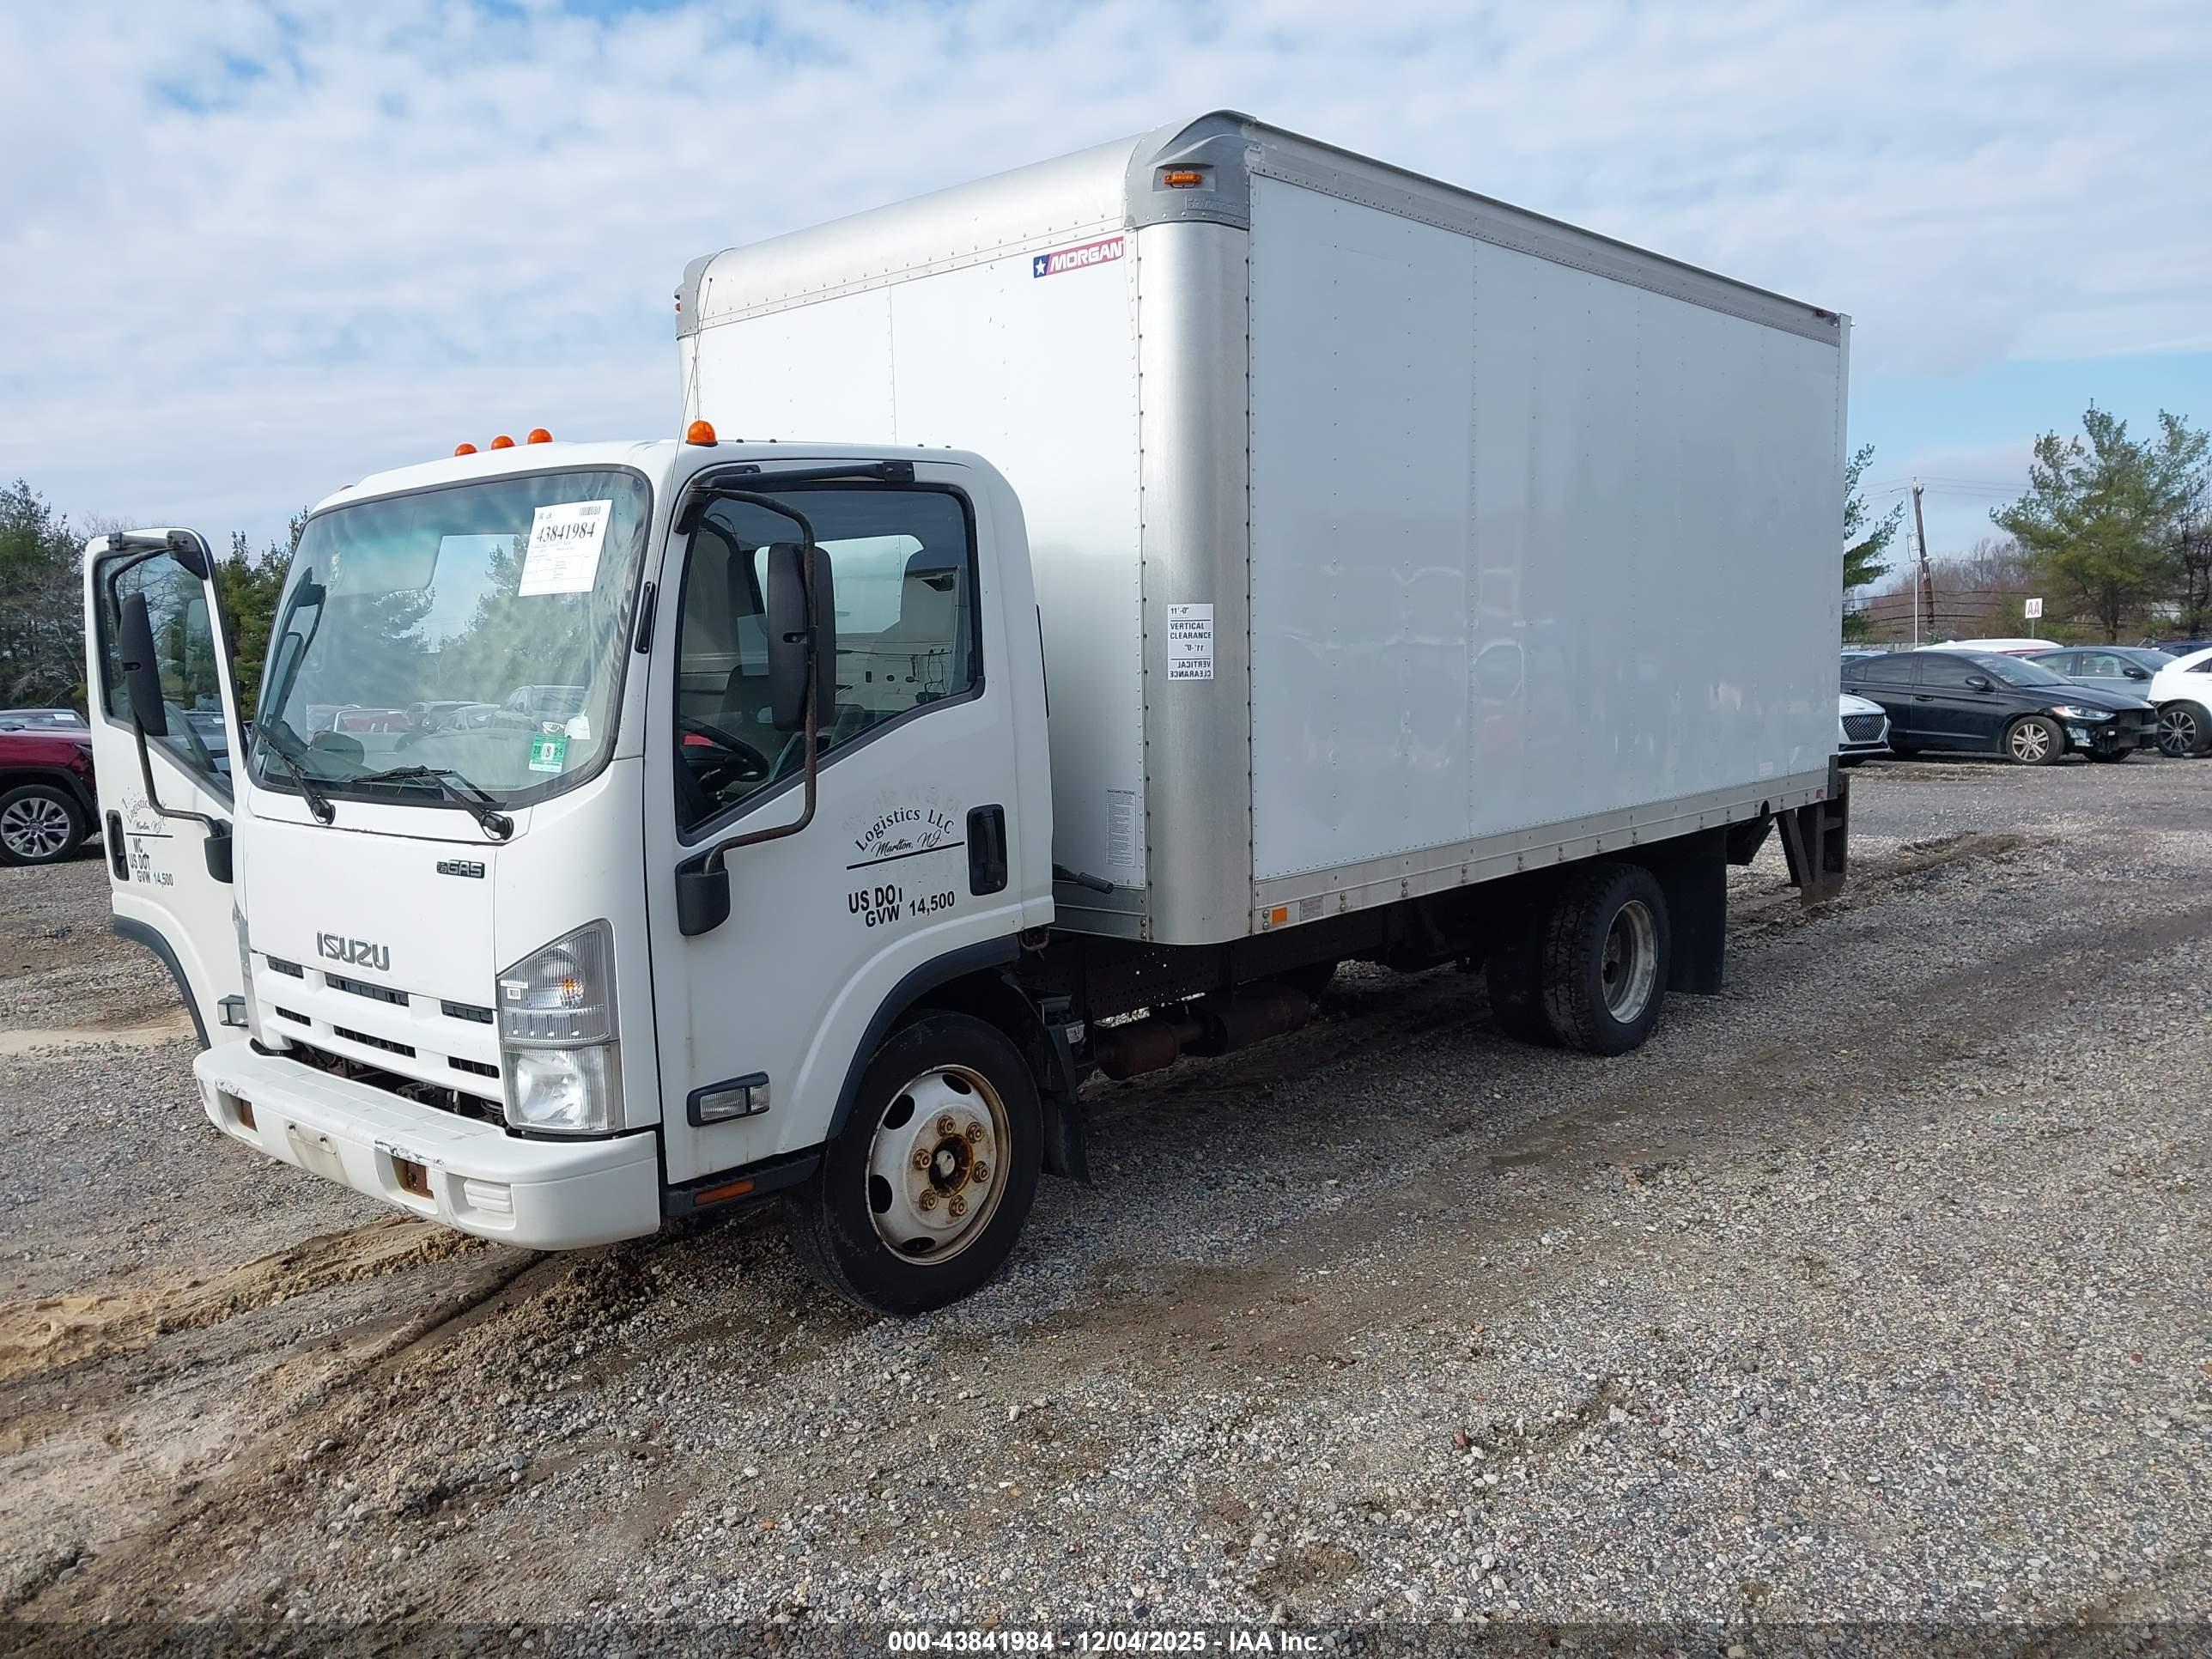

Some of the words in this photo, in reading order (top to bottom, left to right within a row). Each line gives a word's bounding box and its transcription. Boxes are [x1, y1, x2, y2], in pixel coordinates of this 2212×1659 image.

[1049, 240, 1123, 272] MORGAN
[537, 521, 596, 543] 43841984
[1170, 631, 1212, 640] CLEARANCE
[854, 807, 921, 852] Logistics
[927, 809, 954, 835] LLC
[132, 837, 143, 854] MC
[129, 854, 137, 869] US
[137, 870, 150, 884] GVW
[154, 872, 173, 888] 14,500
[848, 890, 869, 914] US
[865, 904, 900, 927] GVW
[909, 890, 955, 916] 14,500
[317, 931, 390, 971] ISUZU
